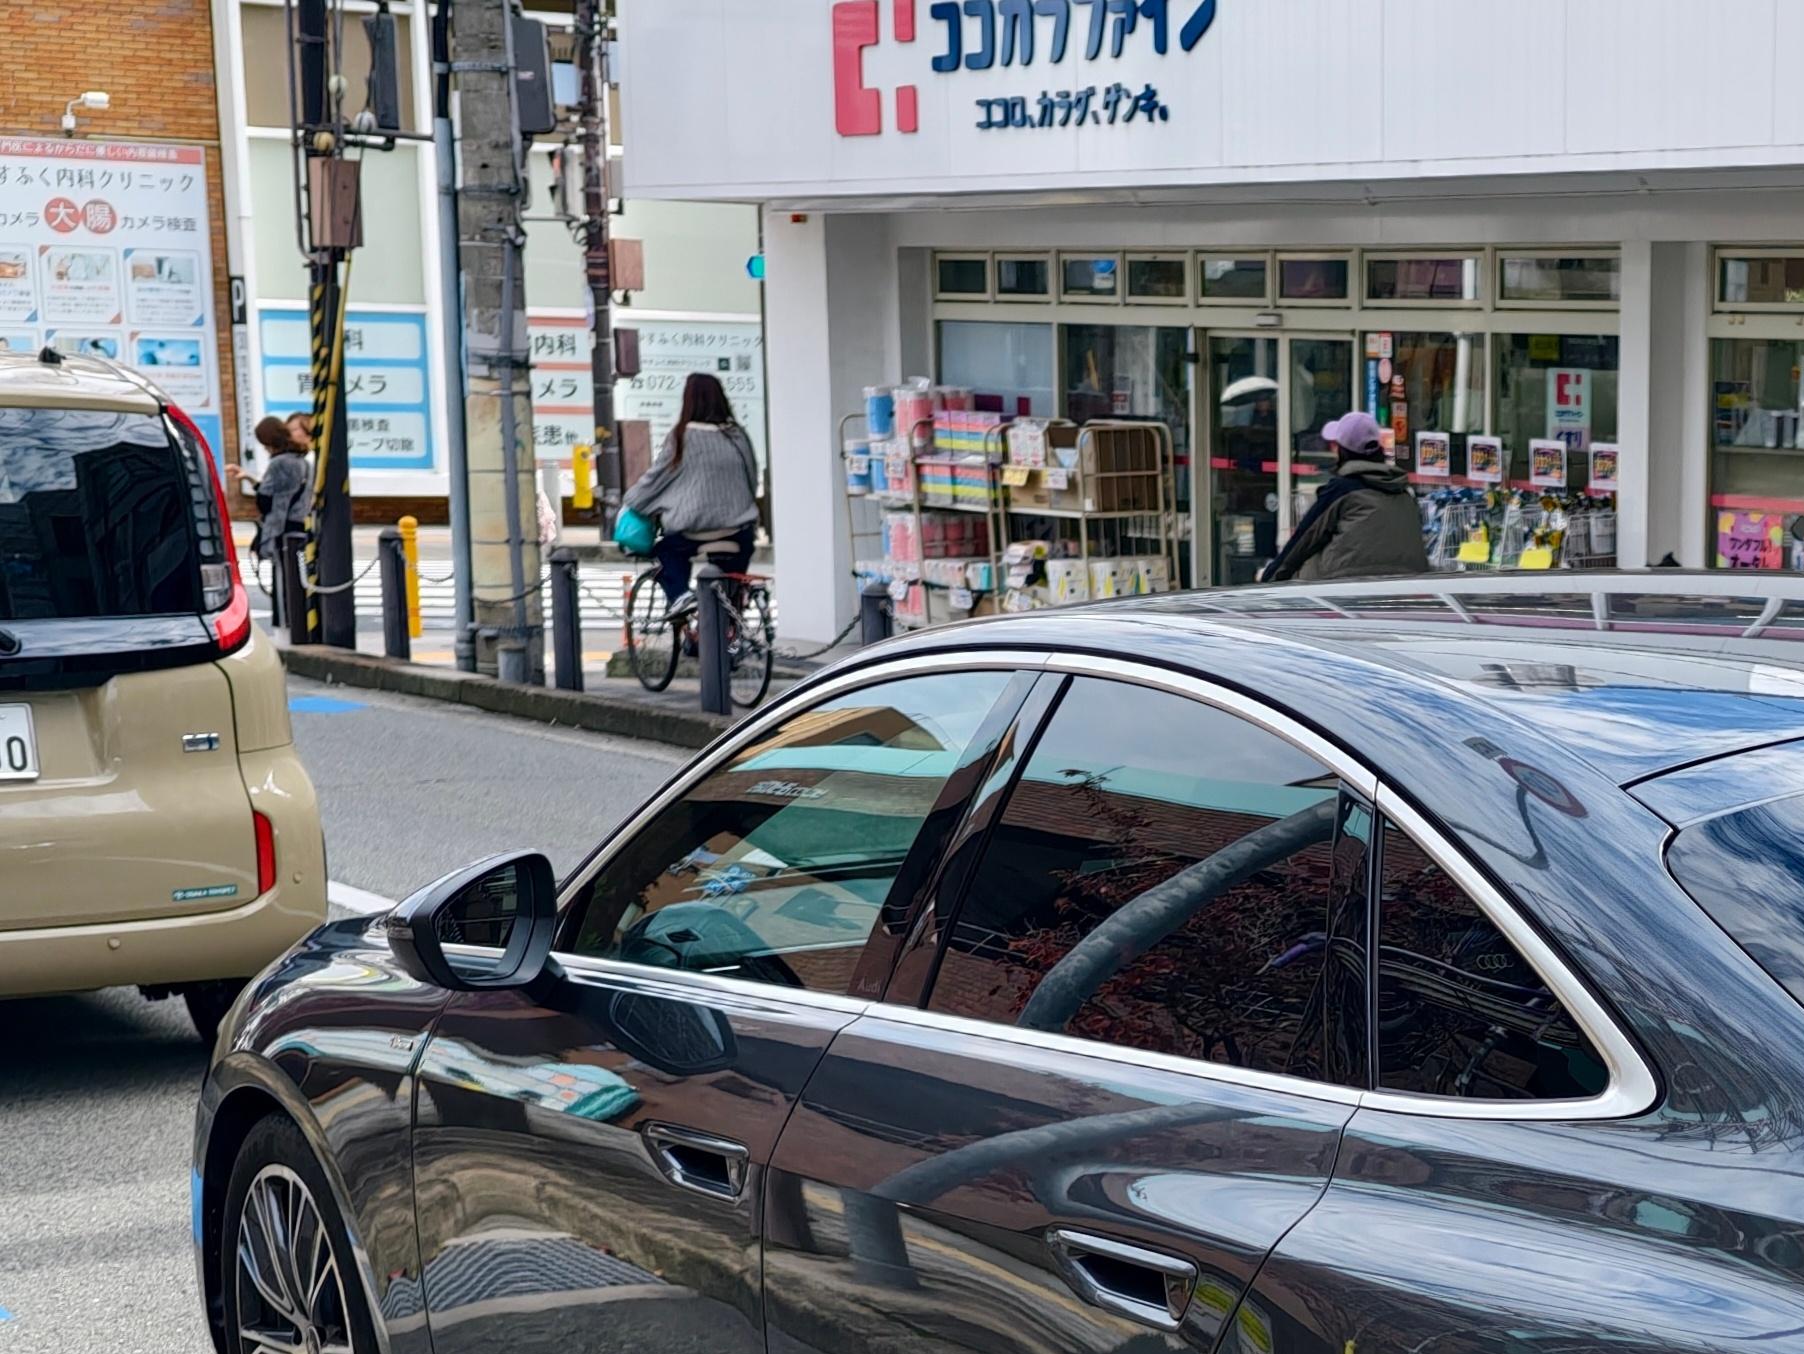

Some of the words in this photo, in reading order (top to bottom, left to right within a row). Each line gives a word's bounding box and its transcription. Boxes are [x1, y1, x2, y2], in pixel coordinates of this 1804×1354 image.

[121, 214, 197, 232] カメラ検査
